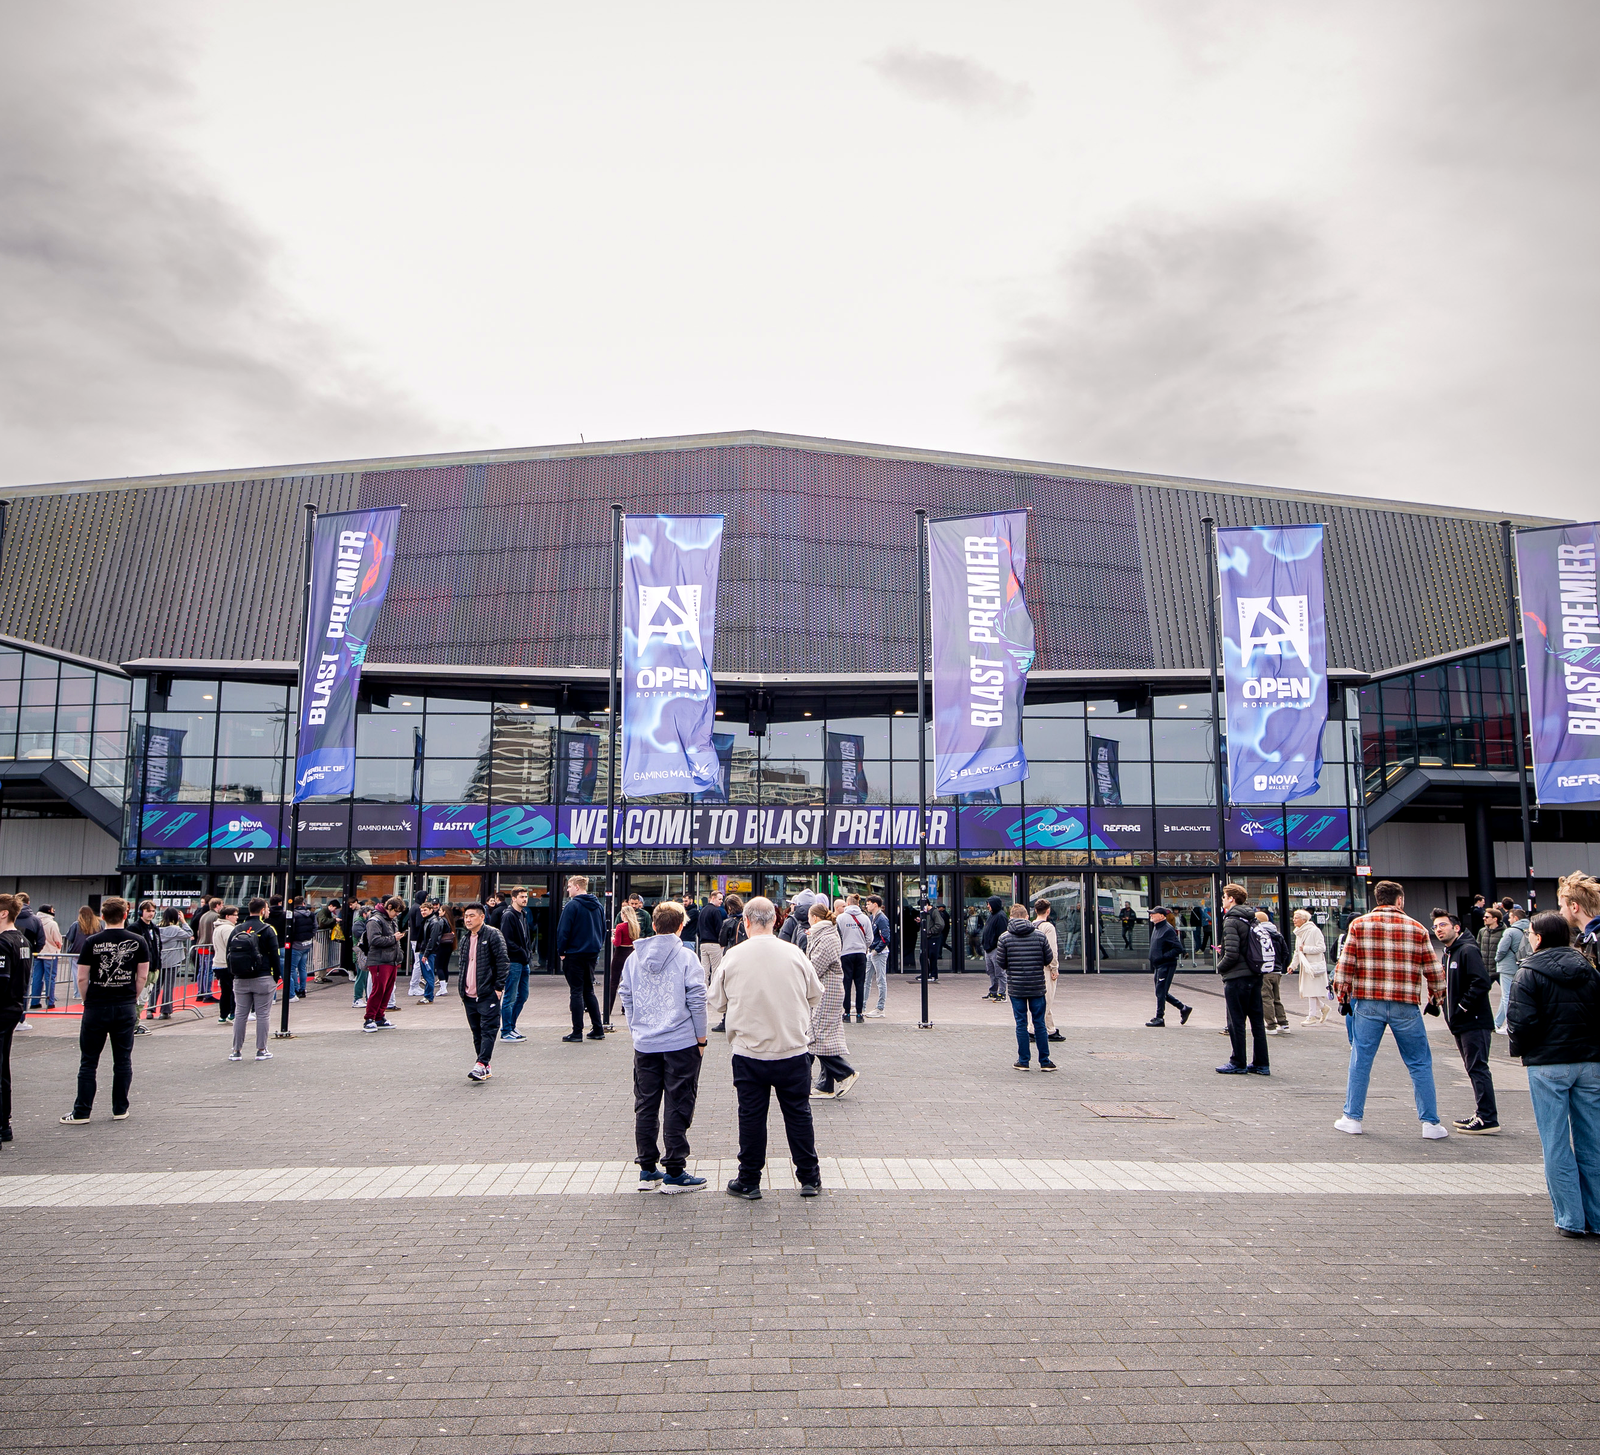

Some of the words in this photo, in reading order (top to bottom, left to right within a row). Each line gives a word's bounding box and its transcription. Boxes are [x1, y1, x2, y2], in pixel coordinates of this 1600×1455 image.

[964, 535, 1001, 644] PREMIER
[1557, 542, 1598, 649] PREMIER
[308, 651, 340, 726] BLAST
[326, 530, 368, 639] PREMIER
[636, 691, 708, 700] ROTTERDAM
[969, 655, 1005, 728] BLAST
[1564, 662, 1600, 736] BLAST
[633, 770, 669, 781] GAMING
[960, 760, 1020, 777] BLACKLYTE
[1268, 775, 1299, 785] NOVA
[1557, 773, 1600, 788] REFR
[432, 822, 476, 831] BLAST.TV
[569, 809, 703, 845] WELCOME
[707, 809, 739, 845] TO
[743, 809, 829, 845] BLAST
[831, 809, 949, 845] PREMIER
[1103, 824, 1141, 832] REFRAG
[233, 851, 255, 863] VIP
